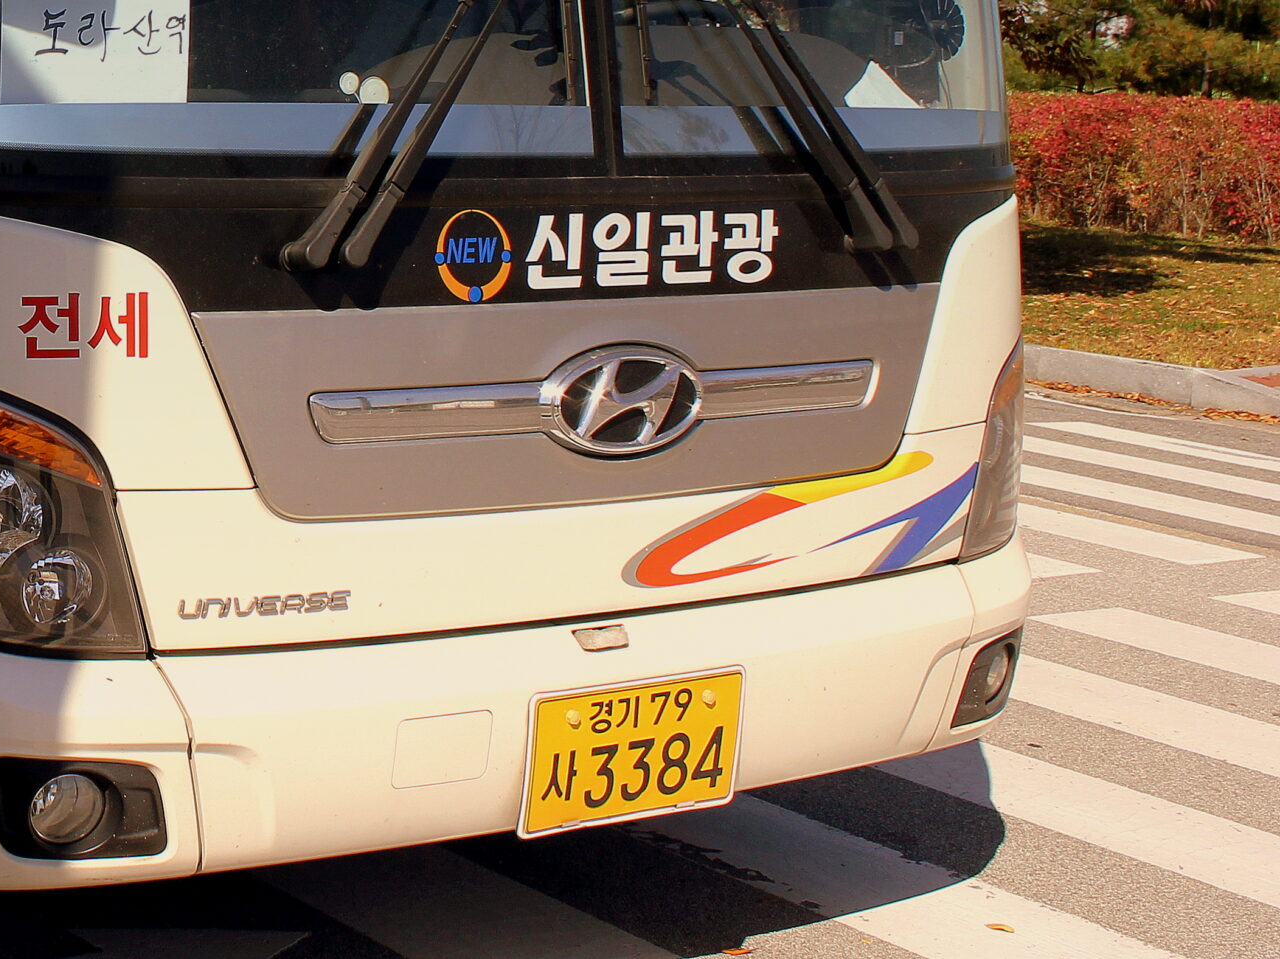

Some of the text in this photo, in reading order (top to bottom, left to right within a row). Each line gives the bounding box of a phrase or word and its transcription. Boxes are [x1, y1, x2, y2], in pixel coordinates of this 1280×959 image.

[34, 8, 187, 63] 도라산역
[446, 237, 498, 264] NEW
[524, 208, 780, 291] 신일관광
[18, 291, 150, 359] 전세
[177, 590, 352, 620] UNIVERSE
[588, 687, 693, 734] 경기 79
